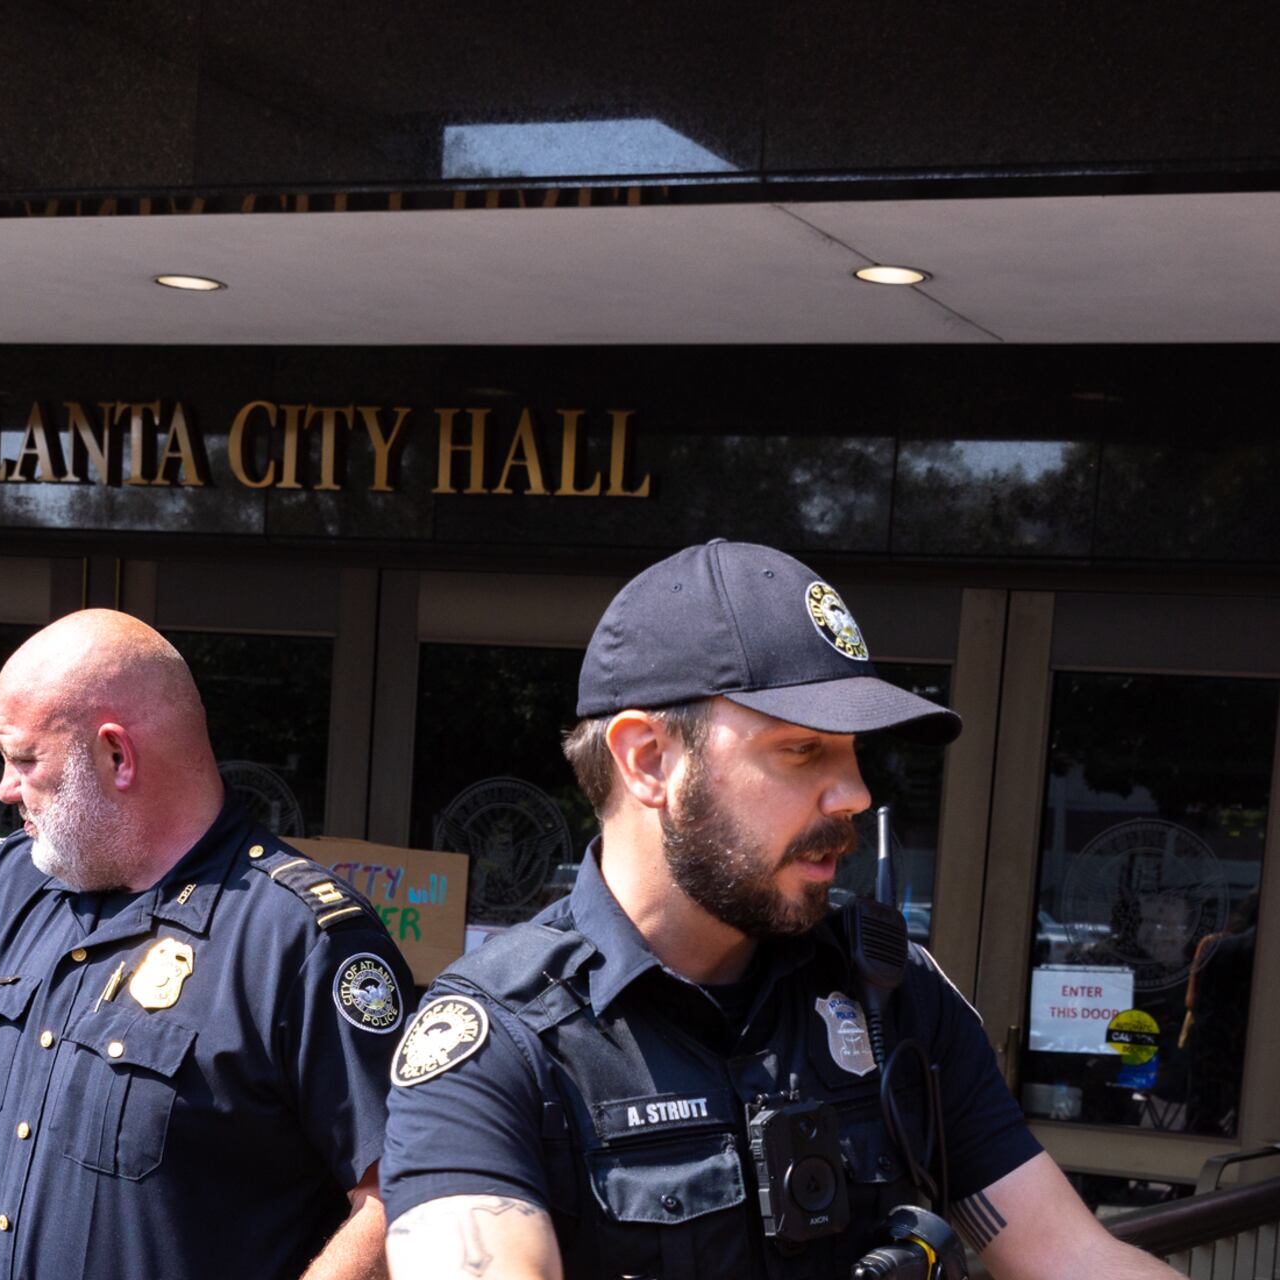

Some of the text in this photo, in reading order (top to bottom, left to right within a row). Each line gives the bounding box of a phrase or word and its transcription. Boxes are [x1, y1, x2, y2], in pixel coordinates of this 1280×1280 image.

[228, 401, 412, 492] CITY
[431, 407, 652, 498] HALL
[375, 904, 422, 942] ER
[345, 964, 359, 980] OF
[360, 960, 396, 993] ATLANTA
[341, 981, 353, 1006] CITY
[1061, 985, 1103, 998] ENTER
[362, 1006, 399, 1027] POLICE
[1050, 1006, 1078, 1019] THIS
[627, 1097, 709, 1127] A. STRUTT
[809, 1216, 830, 1226] AXON
